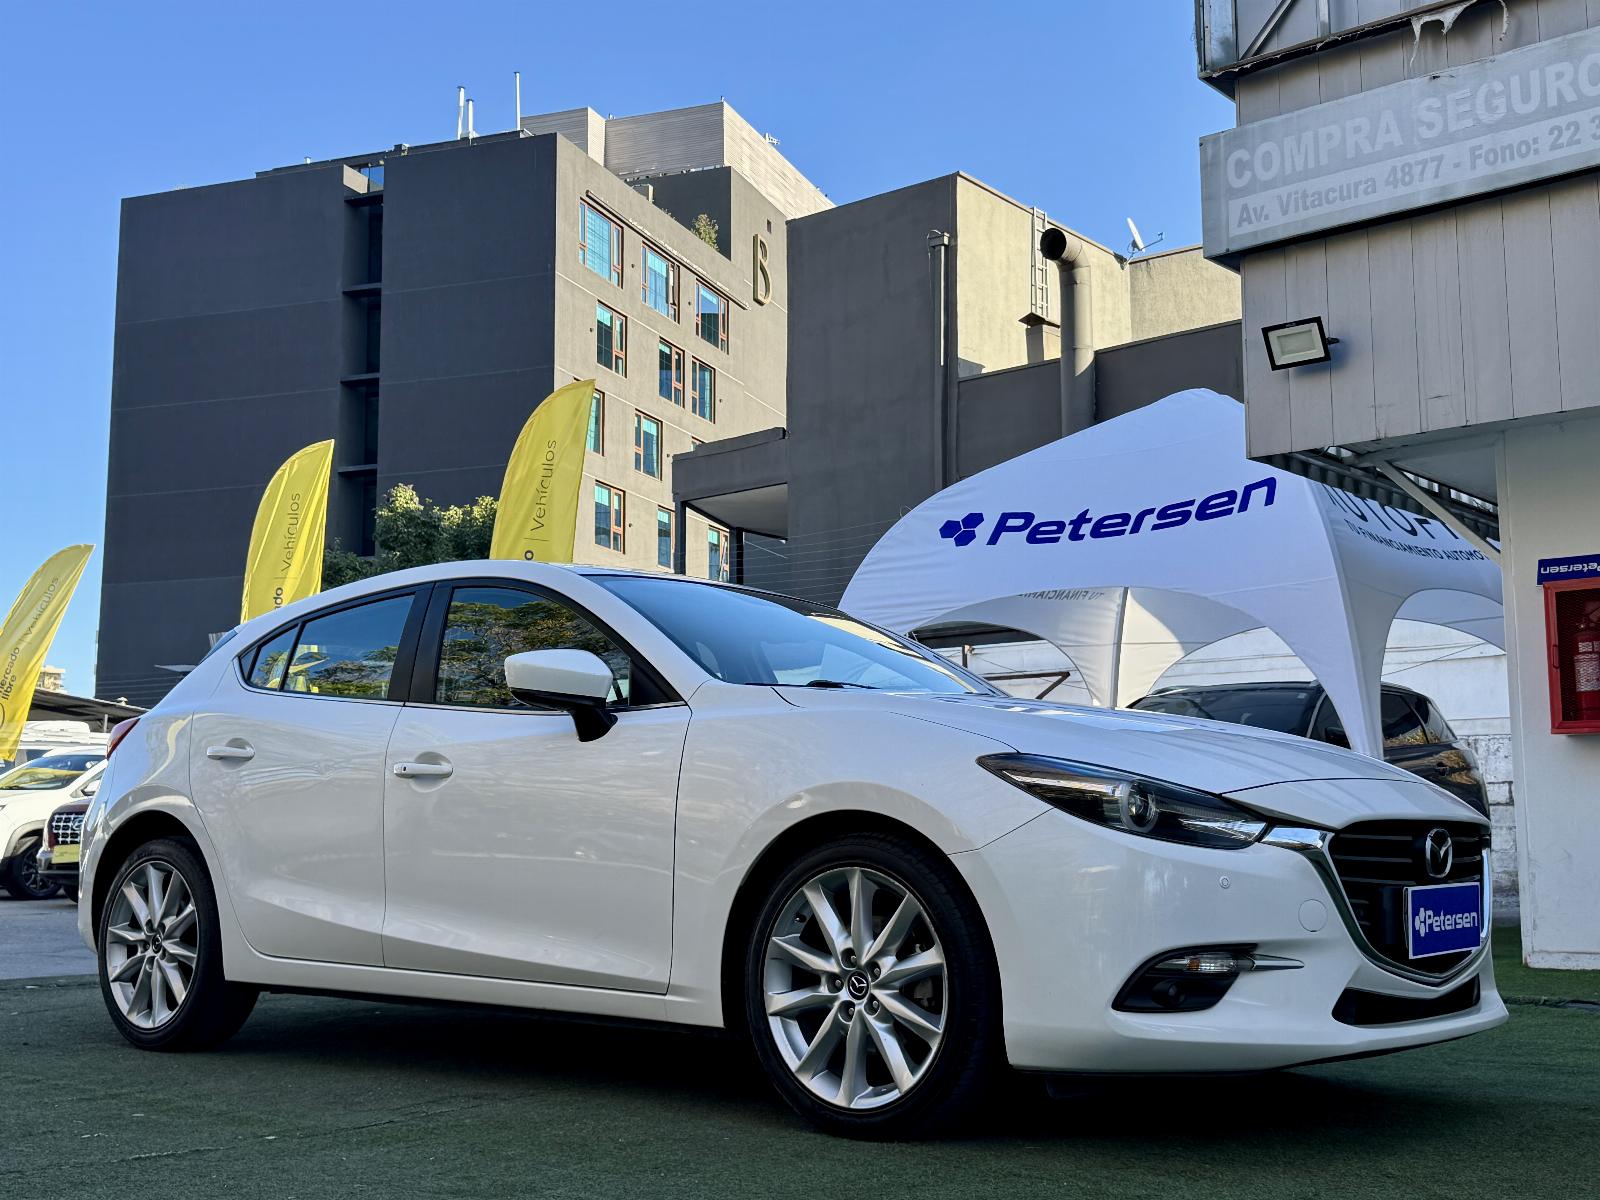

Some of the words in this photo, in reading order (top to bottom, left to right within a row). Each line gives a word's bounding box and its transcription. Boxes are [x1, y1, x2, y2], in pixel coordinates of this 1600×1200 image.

[1226, 110, 1412, 189] COMPRA
[1237, 203, 1269, 228] Av.
[1279, 176, 1377, 217] Vitacura
[1385, 154, 1446, 191] 4877
[1470, 135, 1540, 171] Fono:
[1548, 121, 1582, 151] 22
[530, 439, 557, 532] Vehículos
[986, 476, 1277, 546] Petersen
[281, 493, 301, 572] Vehículos
[1425, 909, 1478, 933] Petersen
